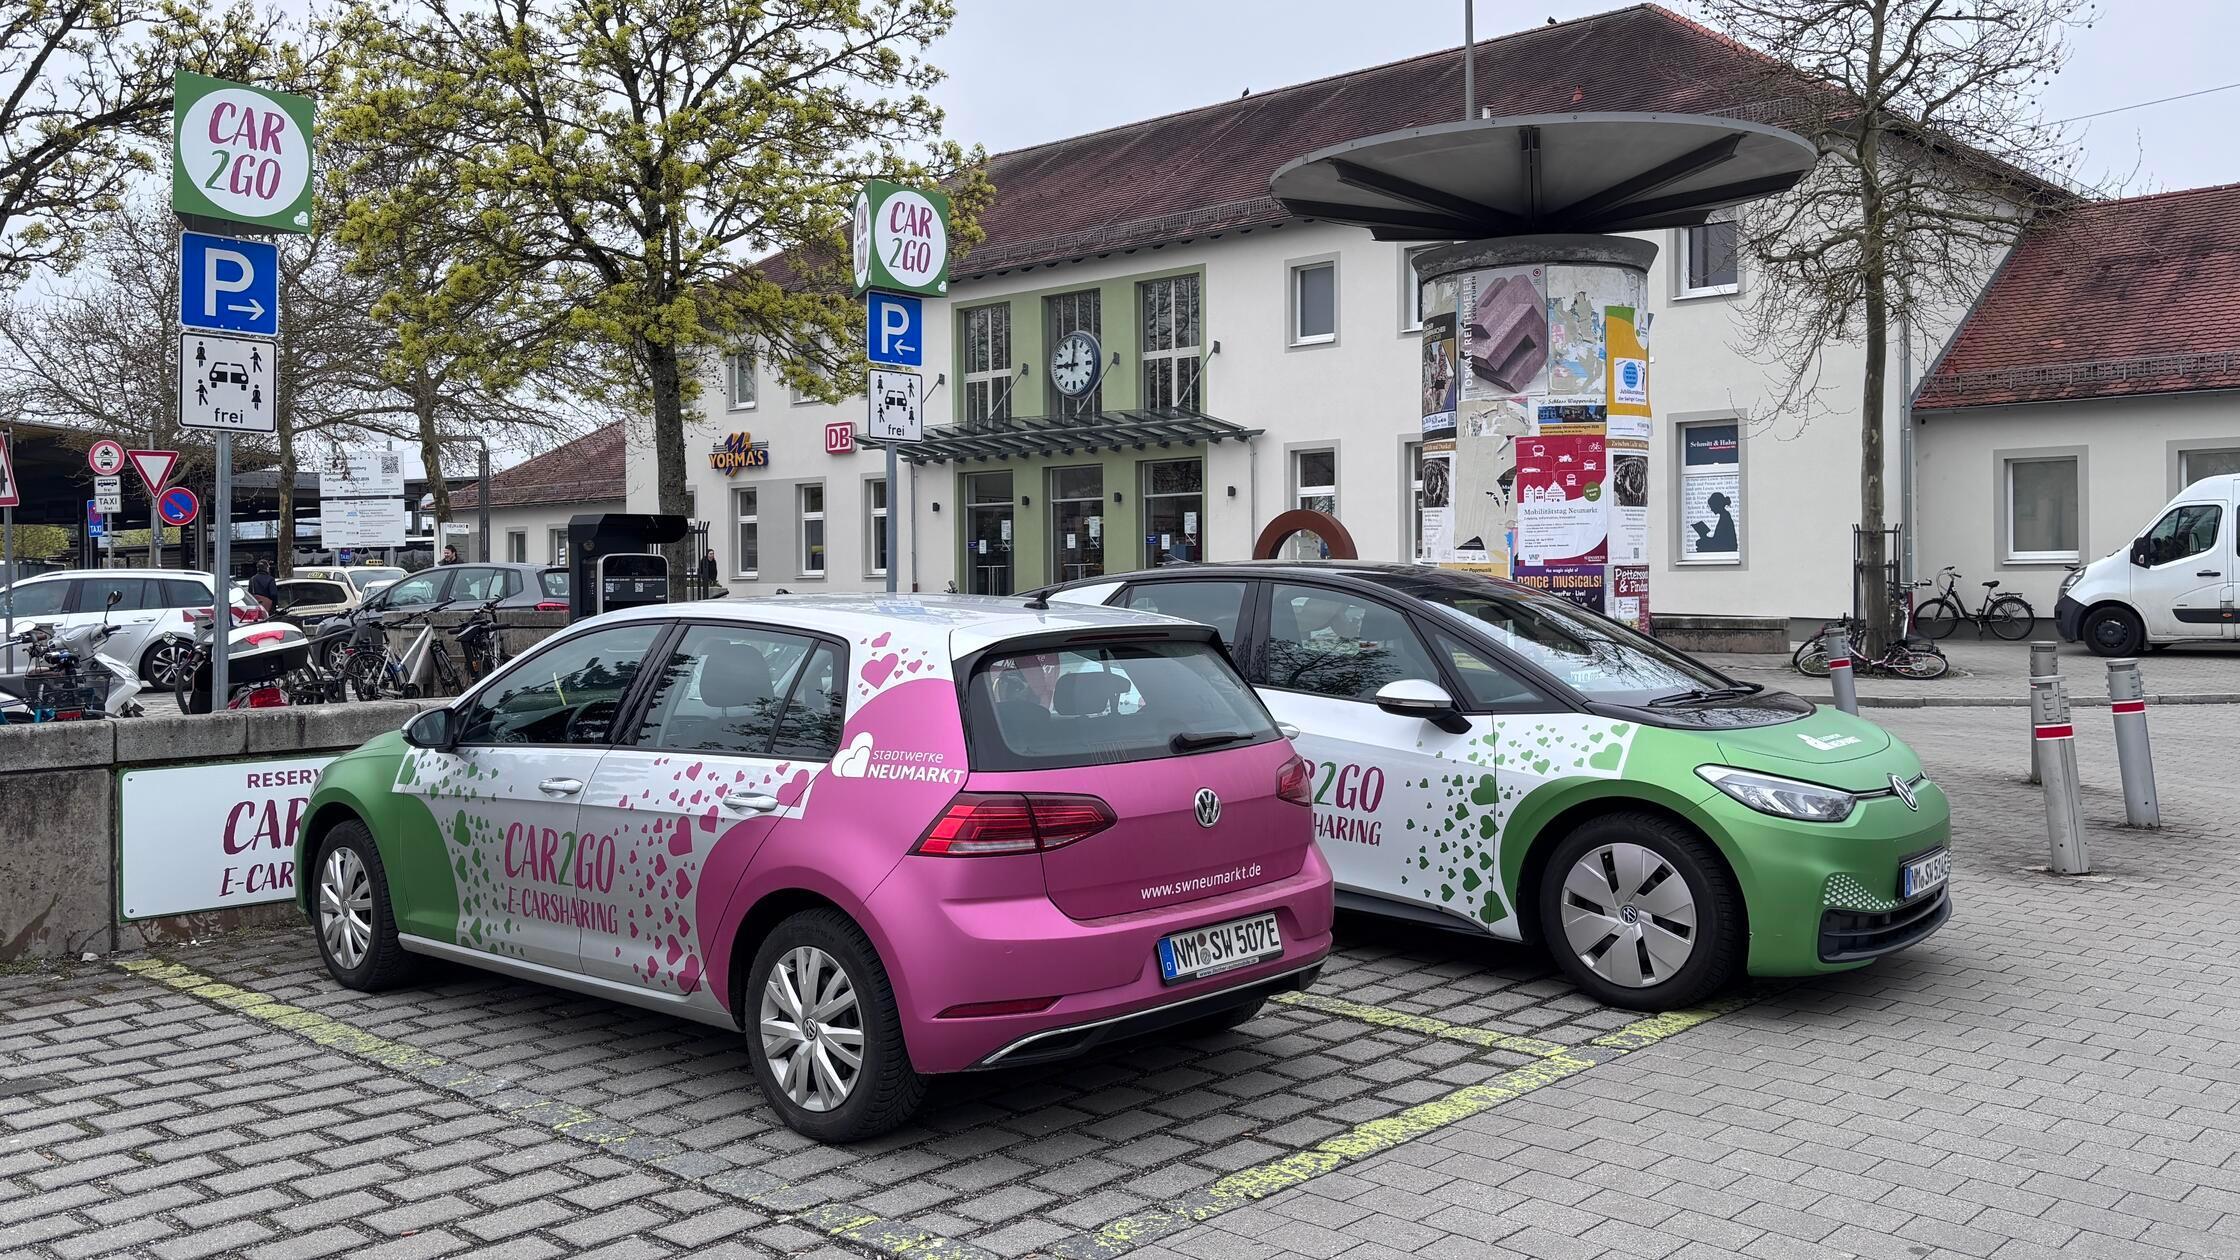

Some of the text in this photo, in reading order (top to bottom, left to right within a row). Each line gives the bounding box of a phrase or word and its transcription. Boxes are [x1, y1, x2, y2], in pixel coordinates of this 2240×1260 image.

[208, 101, 285, 155] CAR
[205, 149, 282, 200] 2GO
[890, 201, 933, 239] CAR
[888, 237, 931, 274] 2GO
[205, 247, 254, 317] P
[881, 302, 910, 354] P
[1463, 277, 1473, 387] OSKAR REITHMEIER
[214, 408, 243, 424] frei
[888, 424, 905, 436] frei
[828, 428, 849, 449] DB
[709, 450, 764, 469] YORMA'S
[90, 525, 102, 533] TAXI
[1619, 580, 1628, 593] &
[868, 764, 965, 785] NEUMARKT
[872, 750, 944, 763] stadtwerke
[504, 821, 615, 894] CAR2GO
[1140, 862, 1262, 900] www.swneumarkt.de
[506, 886, 618, 935] E-CARSHARING
[1172, 935, 1200, 969] NM
[1209, 928, 1234, 960] SW
[1234, 917, 1280, 954] 507E
